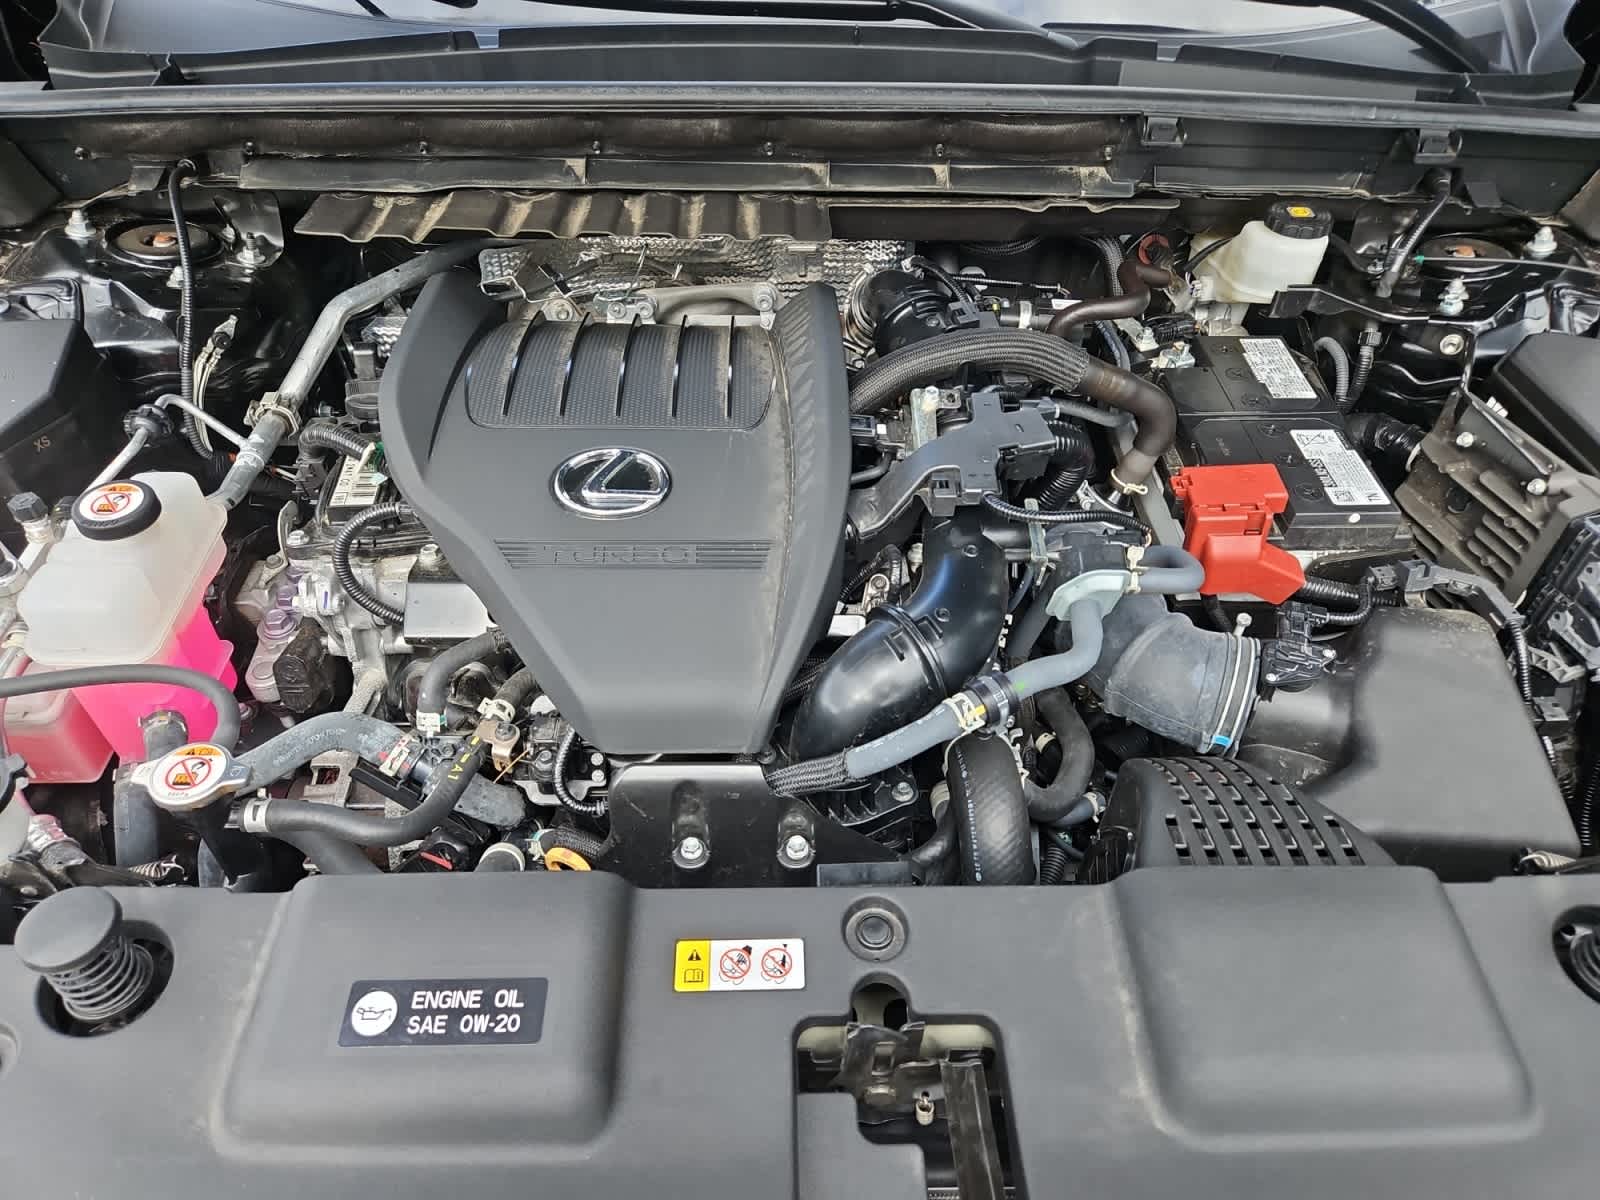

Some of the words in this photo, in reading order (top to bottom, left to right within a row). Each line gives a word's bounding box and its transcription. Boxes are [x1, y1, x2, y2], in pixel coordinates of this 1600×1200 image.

[411, 990, 483, 1009] ENGINE
[494, 989, 524, 1008] OIL
[406, 1015, 448, 1034] SAE
